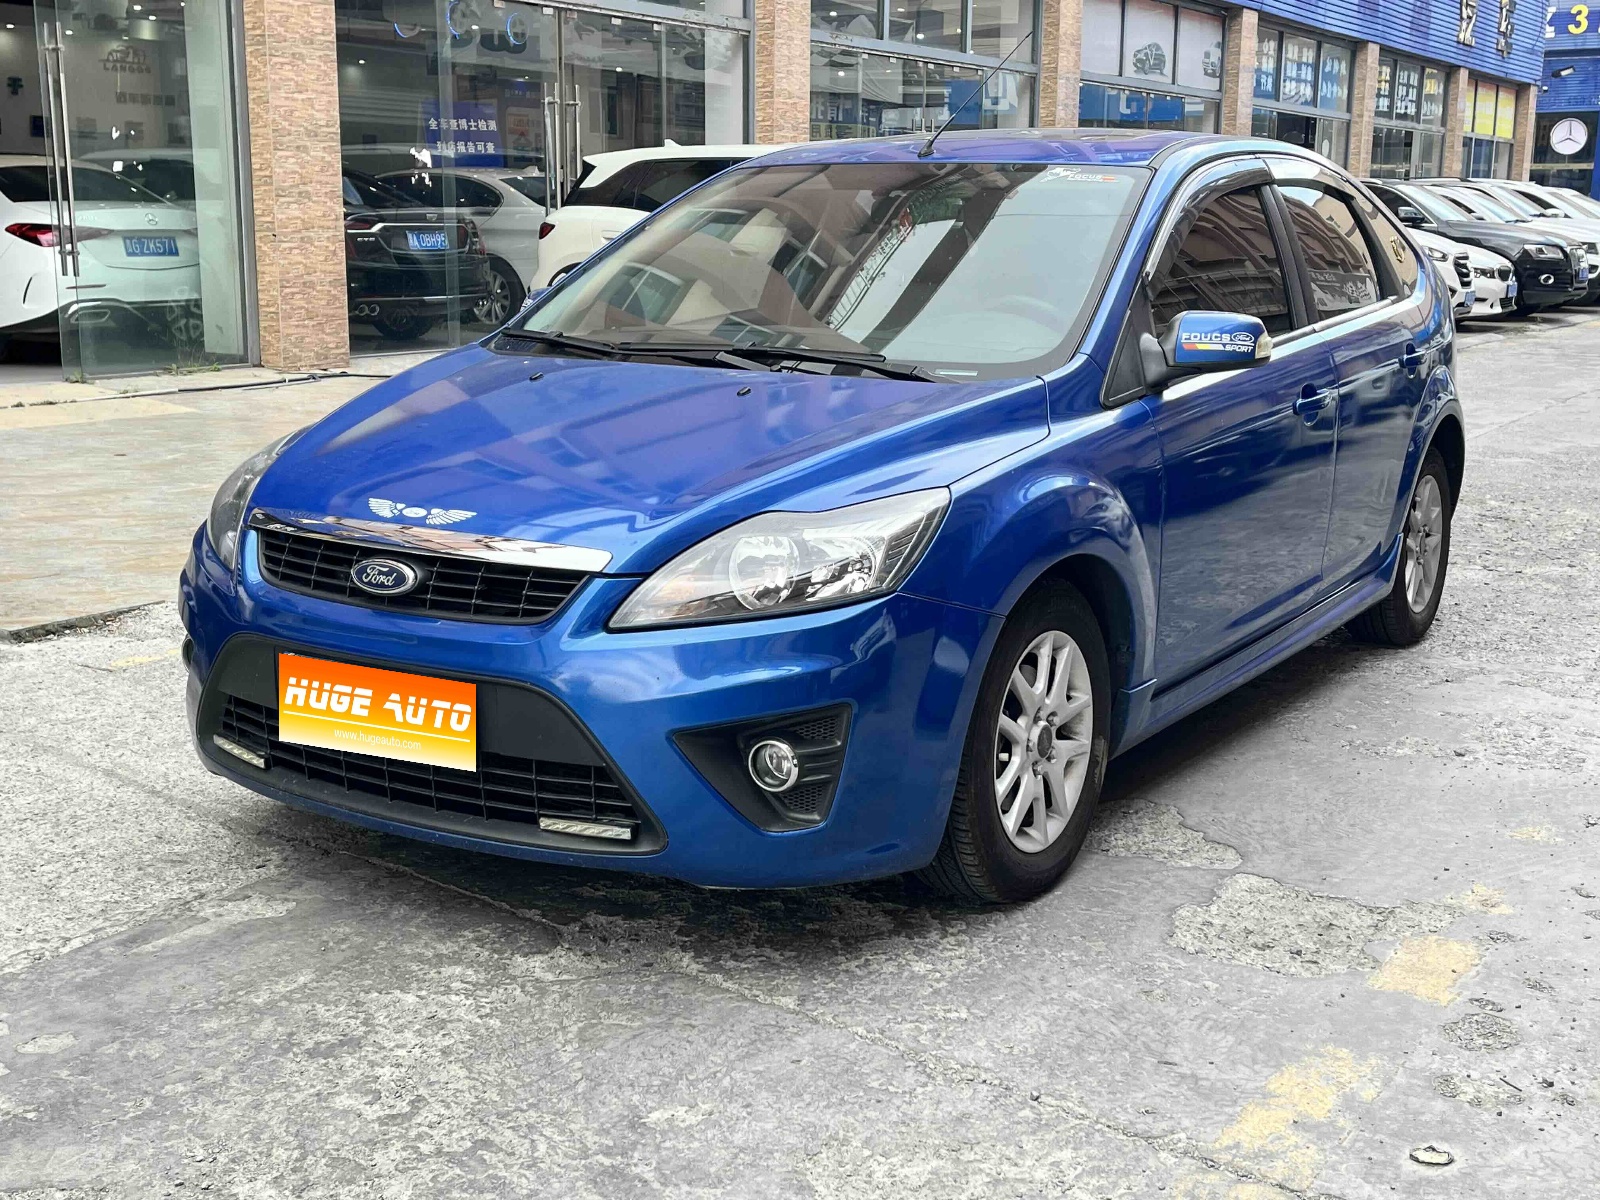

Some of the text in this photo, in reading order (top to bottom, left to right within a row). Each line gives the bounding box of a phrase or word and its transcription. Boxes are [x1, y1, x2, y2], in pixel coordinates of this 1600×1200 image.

[1567, 4, 1589, 35] 3
[428, 118, 497, 131] 全车查博士检测
[1182, 332, 1230, 342] FOUCS
[1224, 344, 1253, 353] SPORT
[362, 564, 397, 586] Ford
